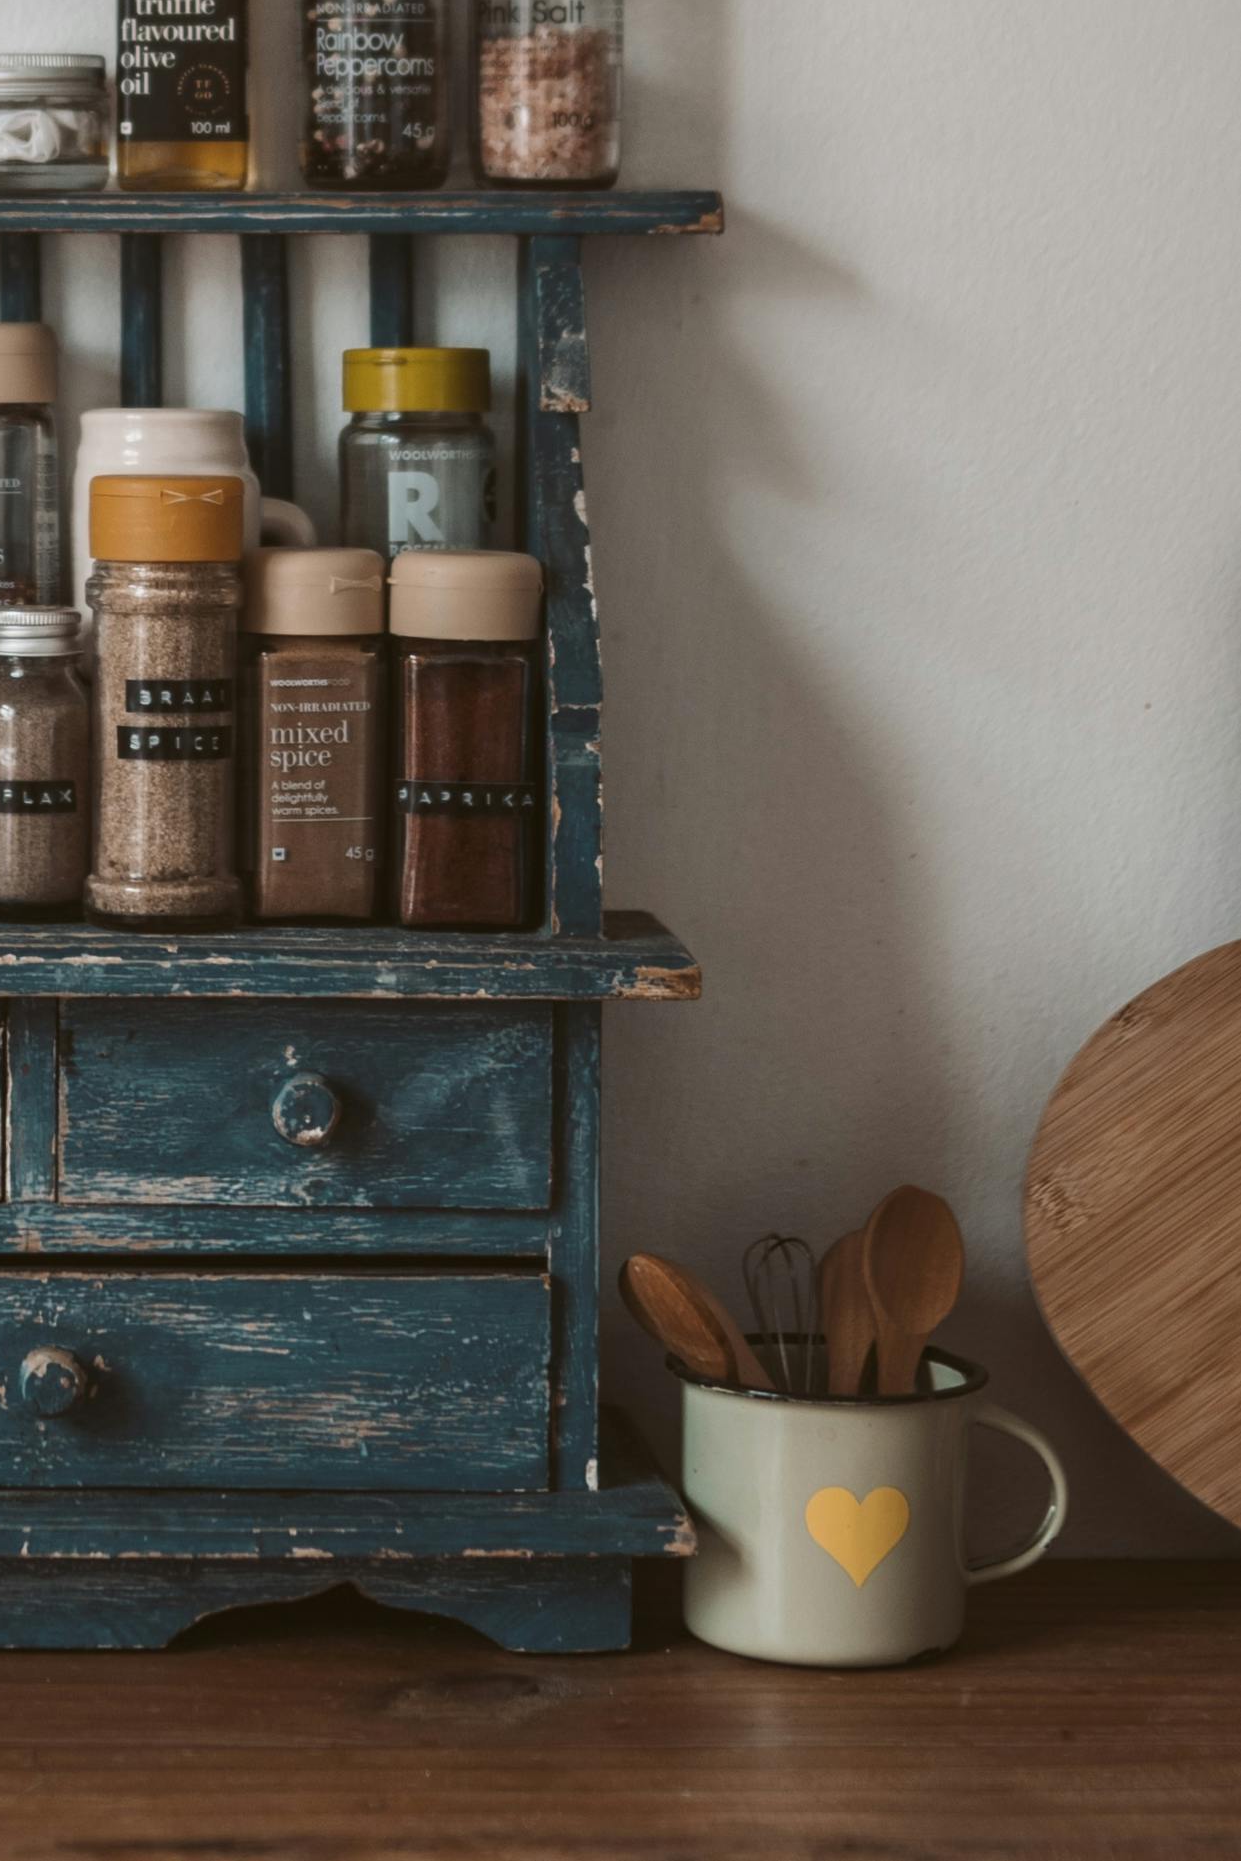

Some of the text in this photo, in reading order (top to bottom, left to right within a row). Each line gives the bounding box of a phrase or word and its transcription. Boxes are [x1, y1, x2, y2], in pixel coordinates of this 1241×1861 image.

[317, 2, 426, 14] NON-IRRADIATED
[479, 0, 585, 24] Pink Salt
[122, 18, 234, 42] flavoured
[317, 27, 404, 51] Rainbow
[121, 45, 176, 69] olive
[317, 52, 434, 80] Peppercorns
[121, 71, 149, 95] oil
[376, 84, 385, 95] &
[191, 122, 231, 134] 100 ml
[552, 111, 578, 128] 100
[402, 123, 422, 138] 45
[387, 471, 445, 542] R
[270, 702, 371, 713] NON-IRRADIATED
[270, 720, 350, 744] mixed
[129, 734, 220, 751] SPICE
[270, 744, 332, 772] spice
[271, 780, 326, 790] A blend of
[2, 788, 72, 804] FLAX
[271, 792, 328, 805] delightfully
[398, 788, 534, 807] PAPRIKA
[271, 805, 339, 816] warm spices.
[345, 846, 374, 862] 45 g
